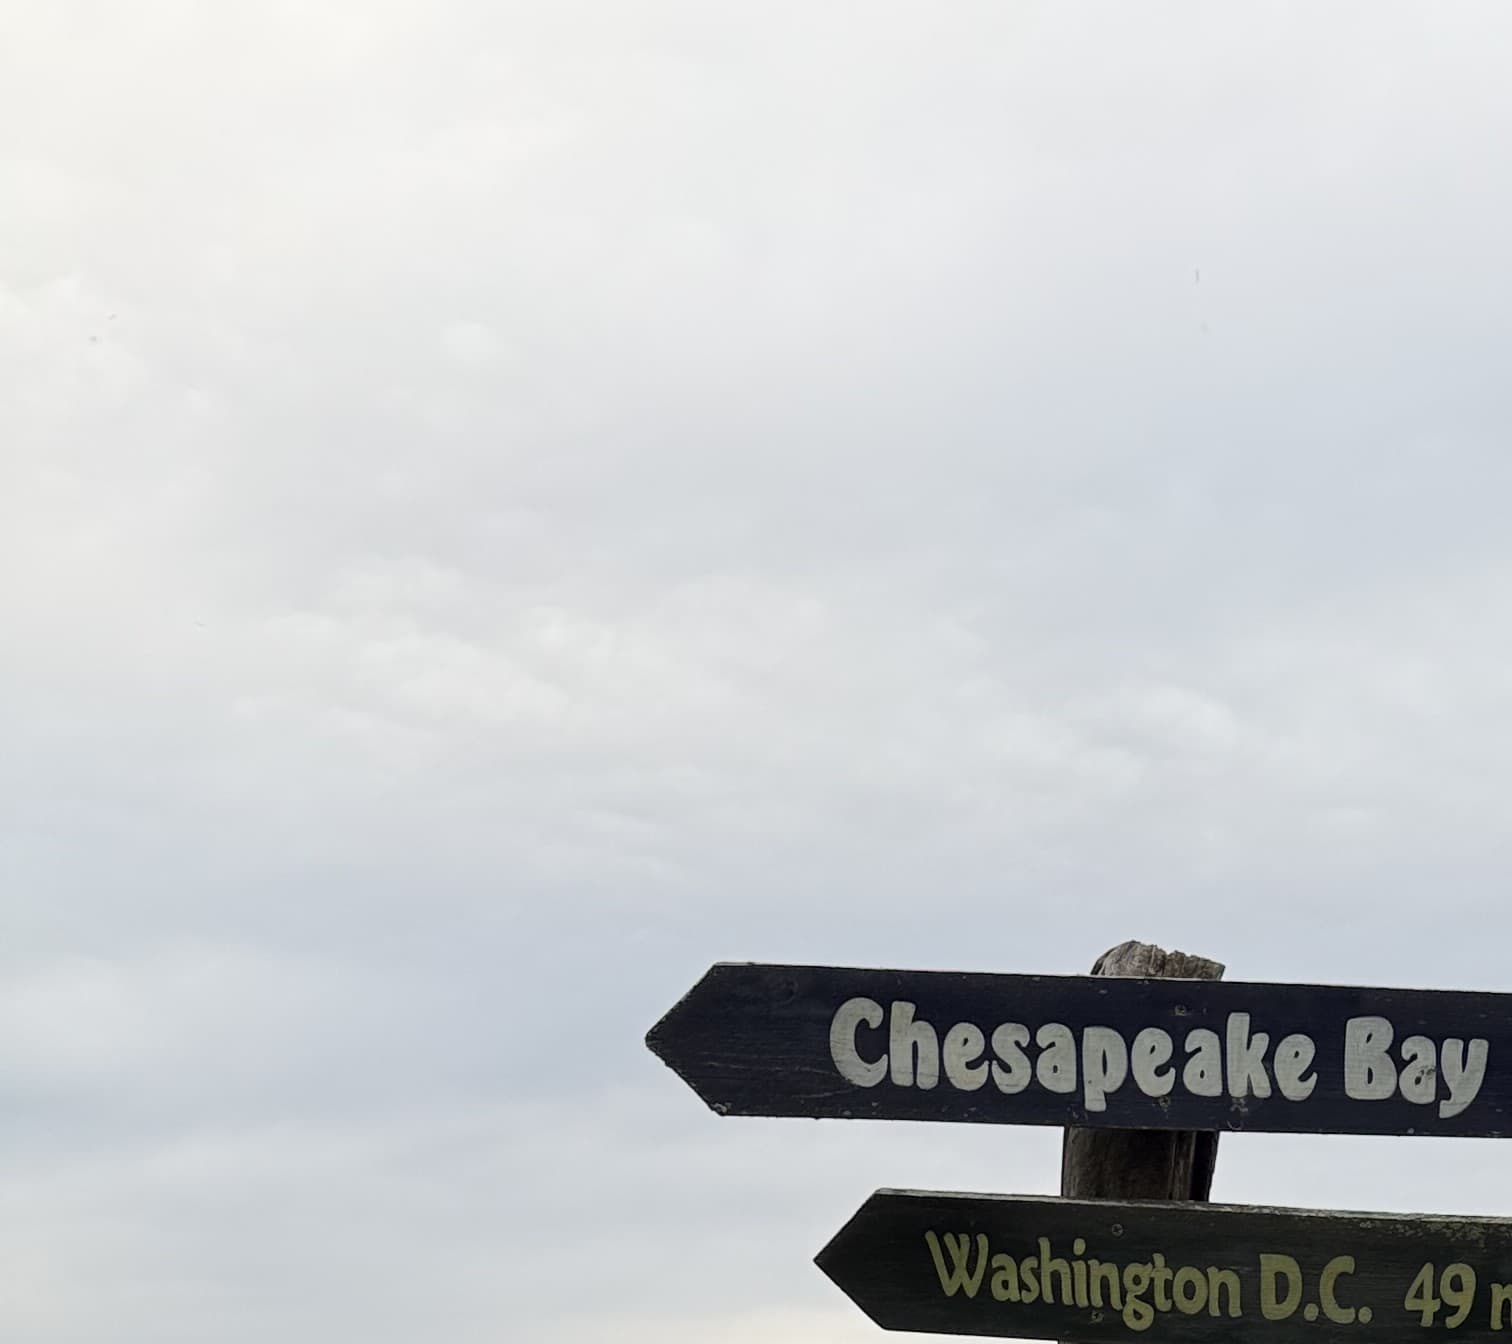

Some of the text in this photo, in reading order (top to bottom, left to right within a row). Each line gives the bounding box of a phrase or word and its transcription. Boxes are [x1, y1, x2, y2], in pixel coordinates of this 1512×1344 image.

[829, 996, 1489, 1118] Chesapeake Bay
[924, 1229, 1243, 1331] Washington
[1258, 1252, 1373, 1326] D.C.
[1403, 1263, 1478, 1330] 49
